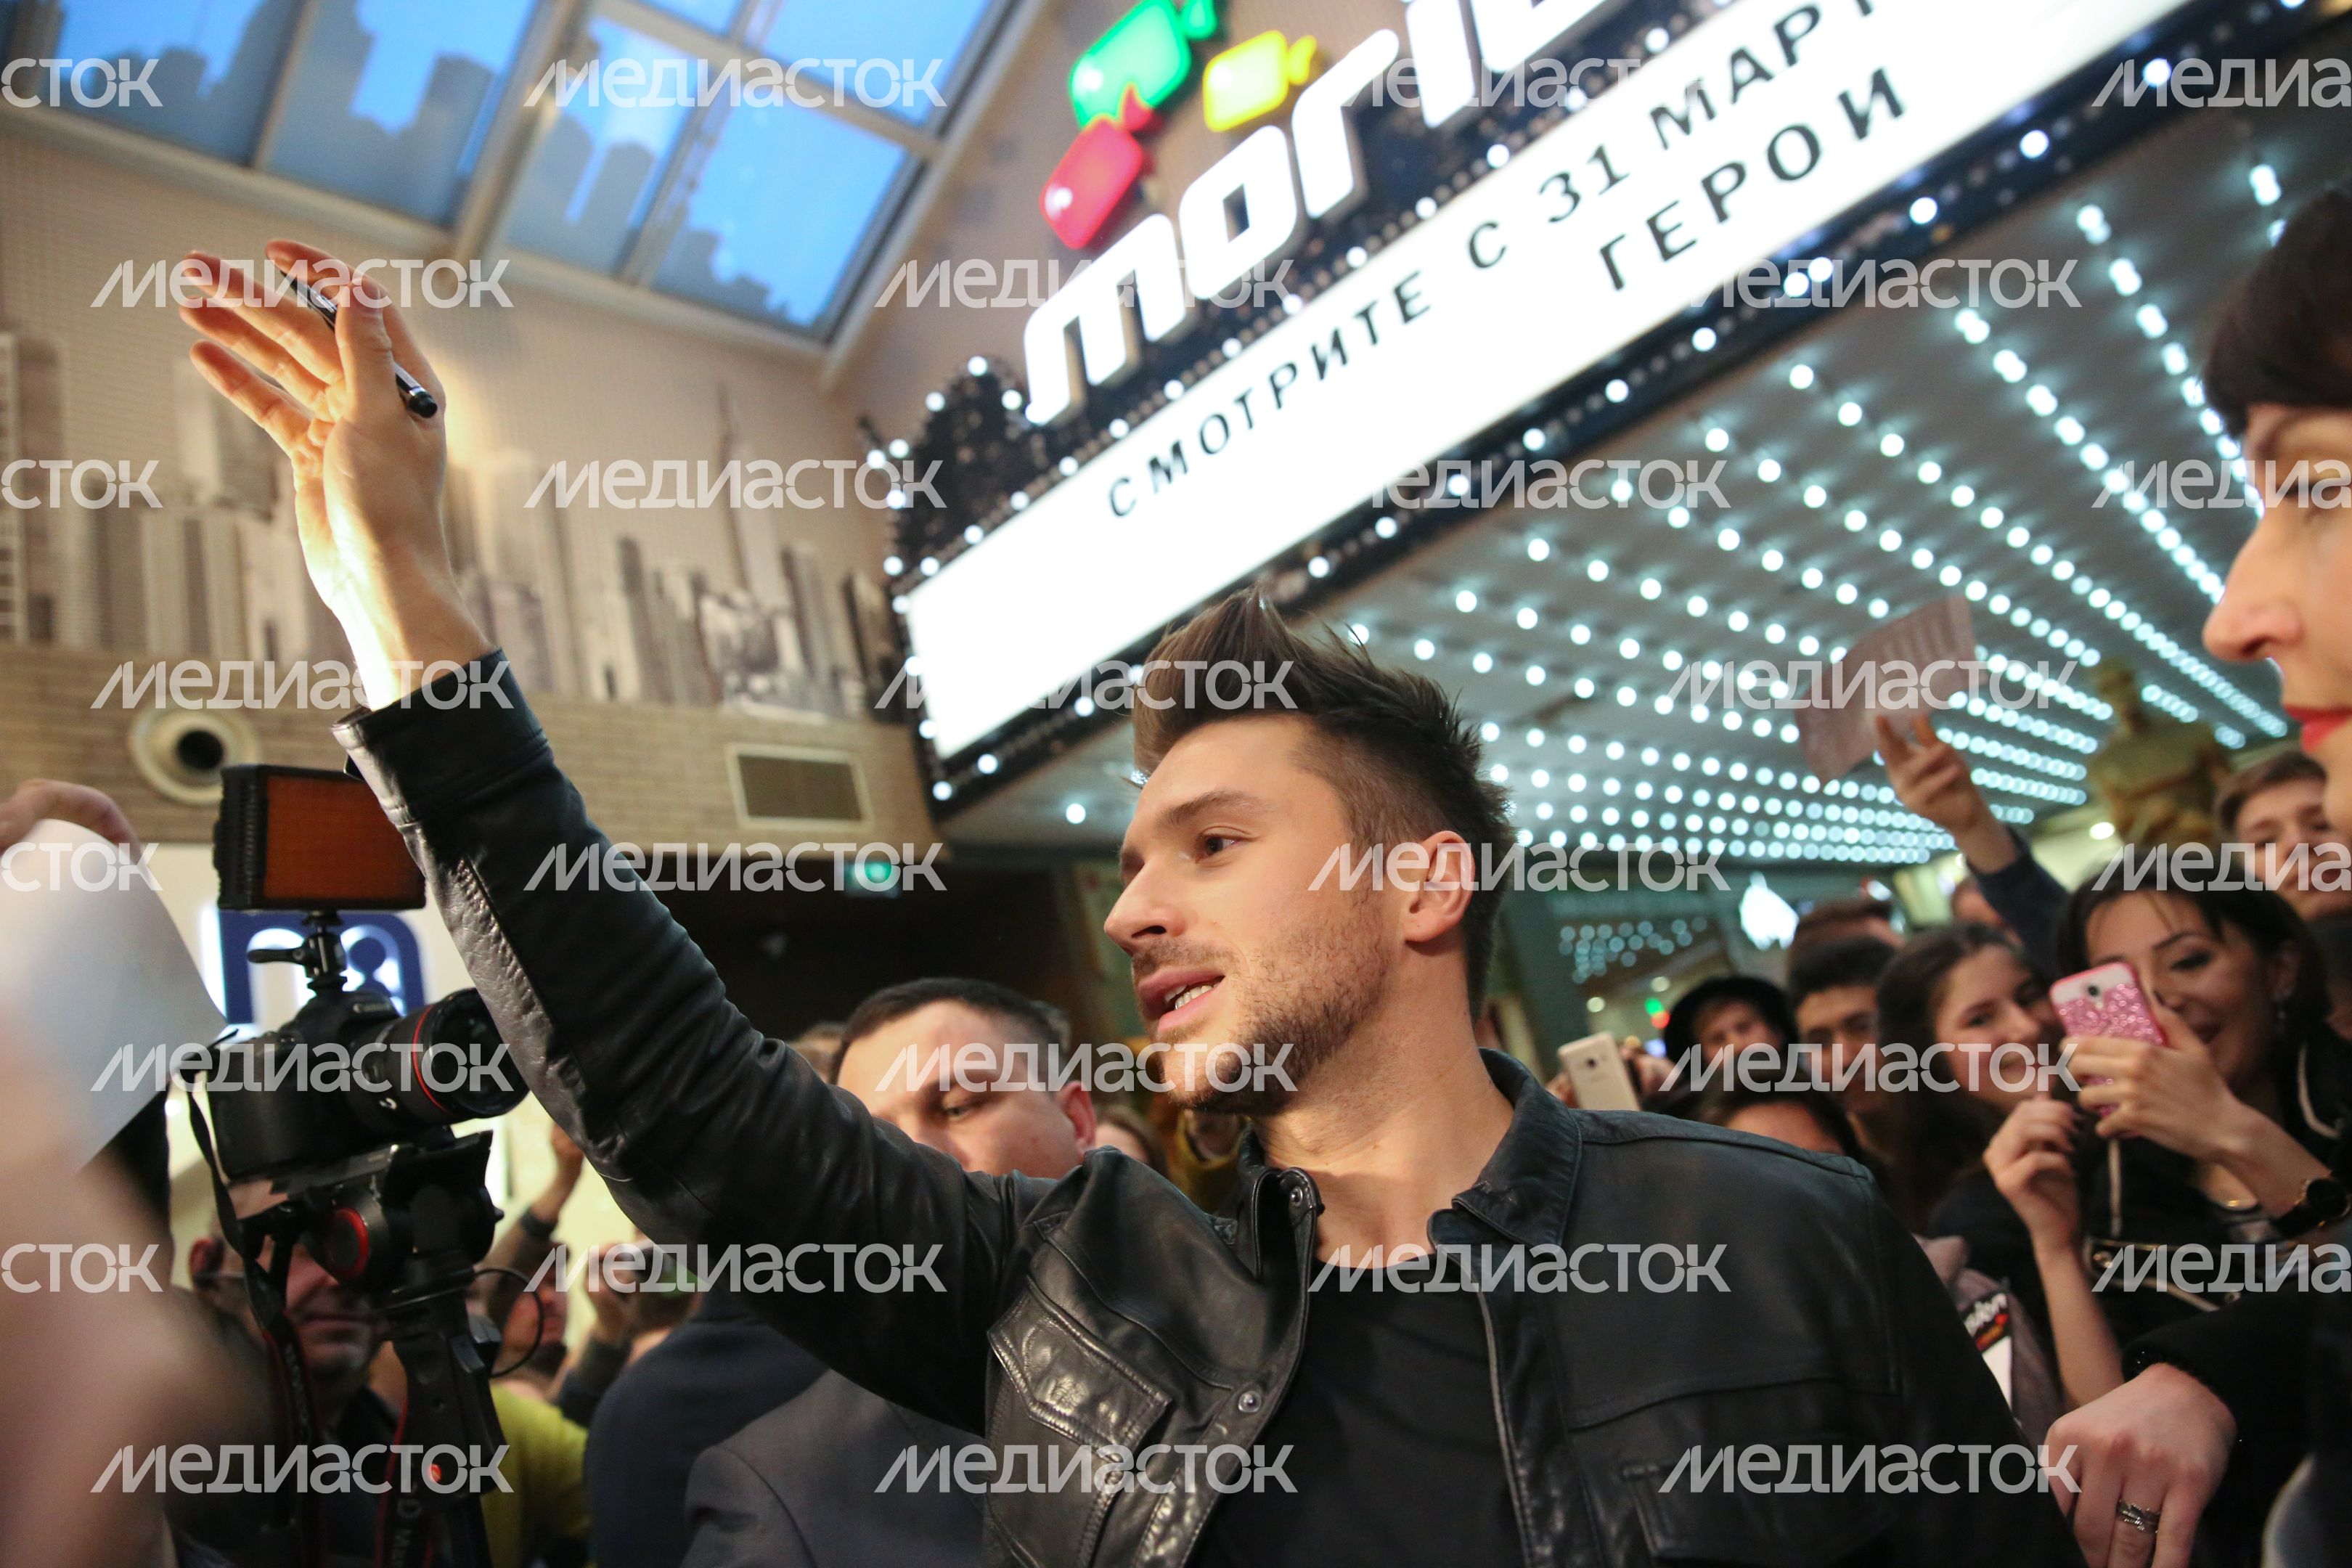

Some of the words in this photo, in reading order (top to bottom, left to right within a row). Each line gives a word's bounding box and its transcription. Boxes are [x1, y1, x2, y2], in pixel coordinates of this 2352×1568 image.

[1024, 0, 1601, 425] mori
[1108, 270, 1432, 518] СМОТРИТЕ
[1538, 144, 1631, 224] 31
[1598, 67, 1905, 291] ГЕРОИ
